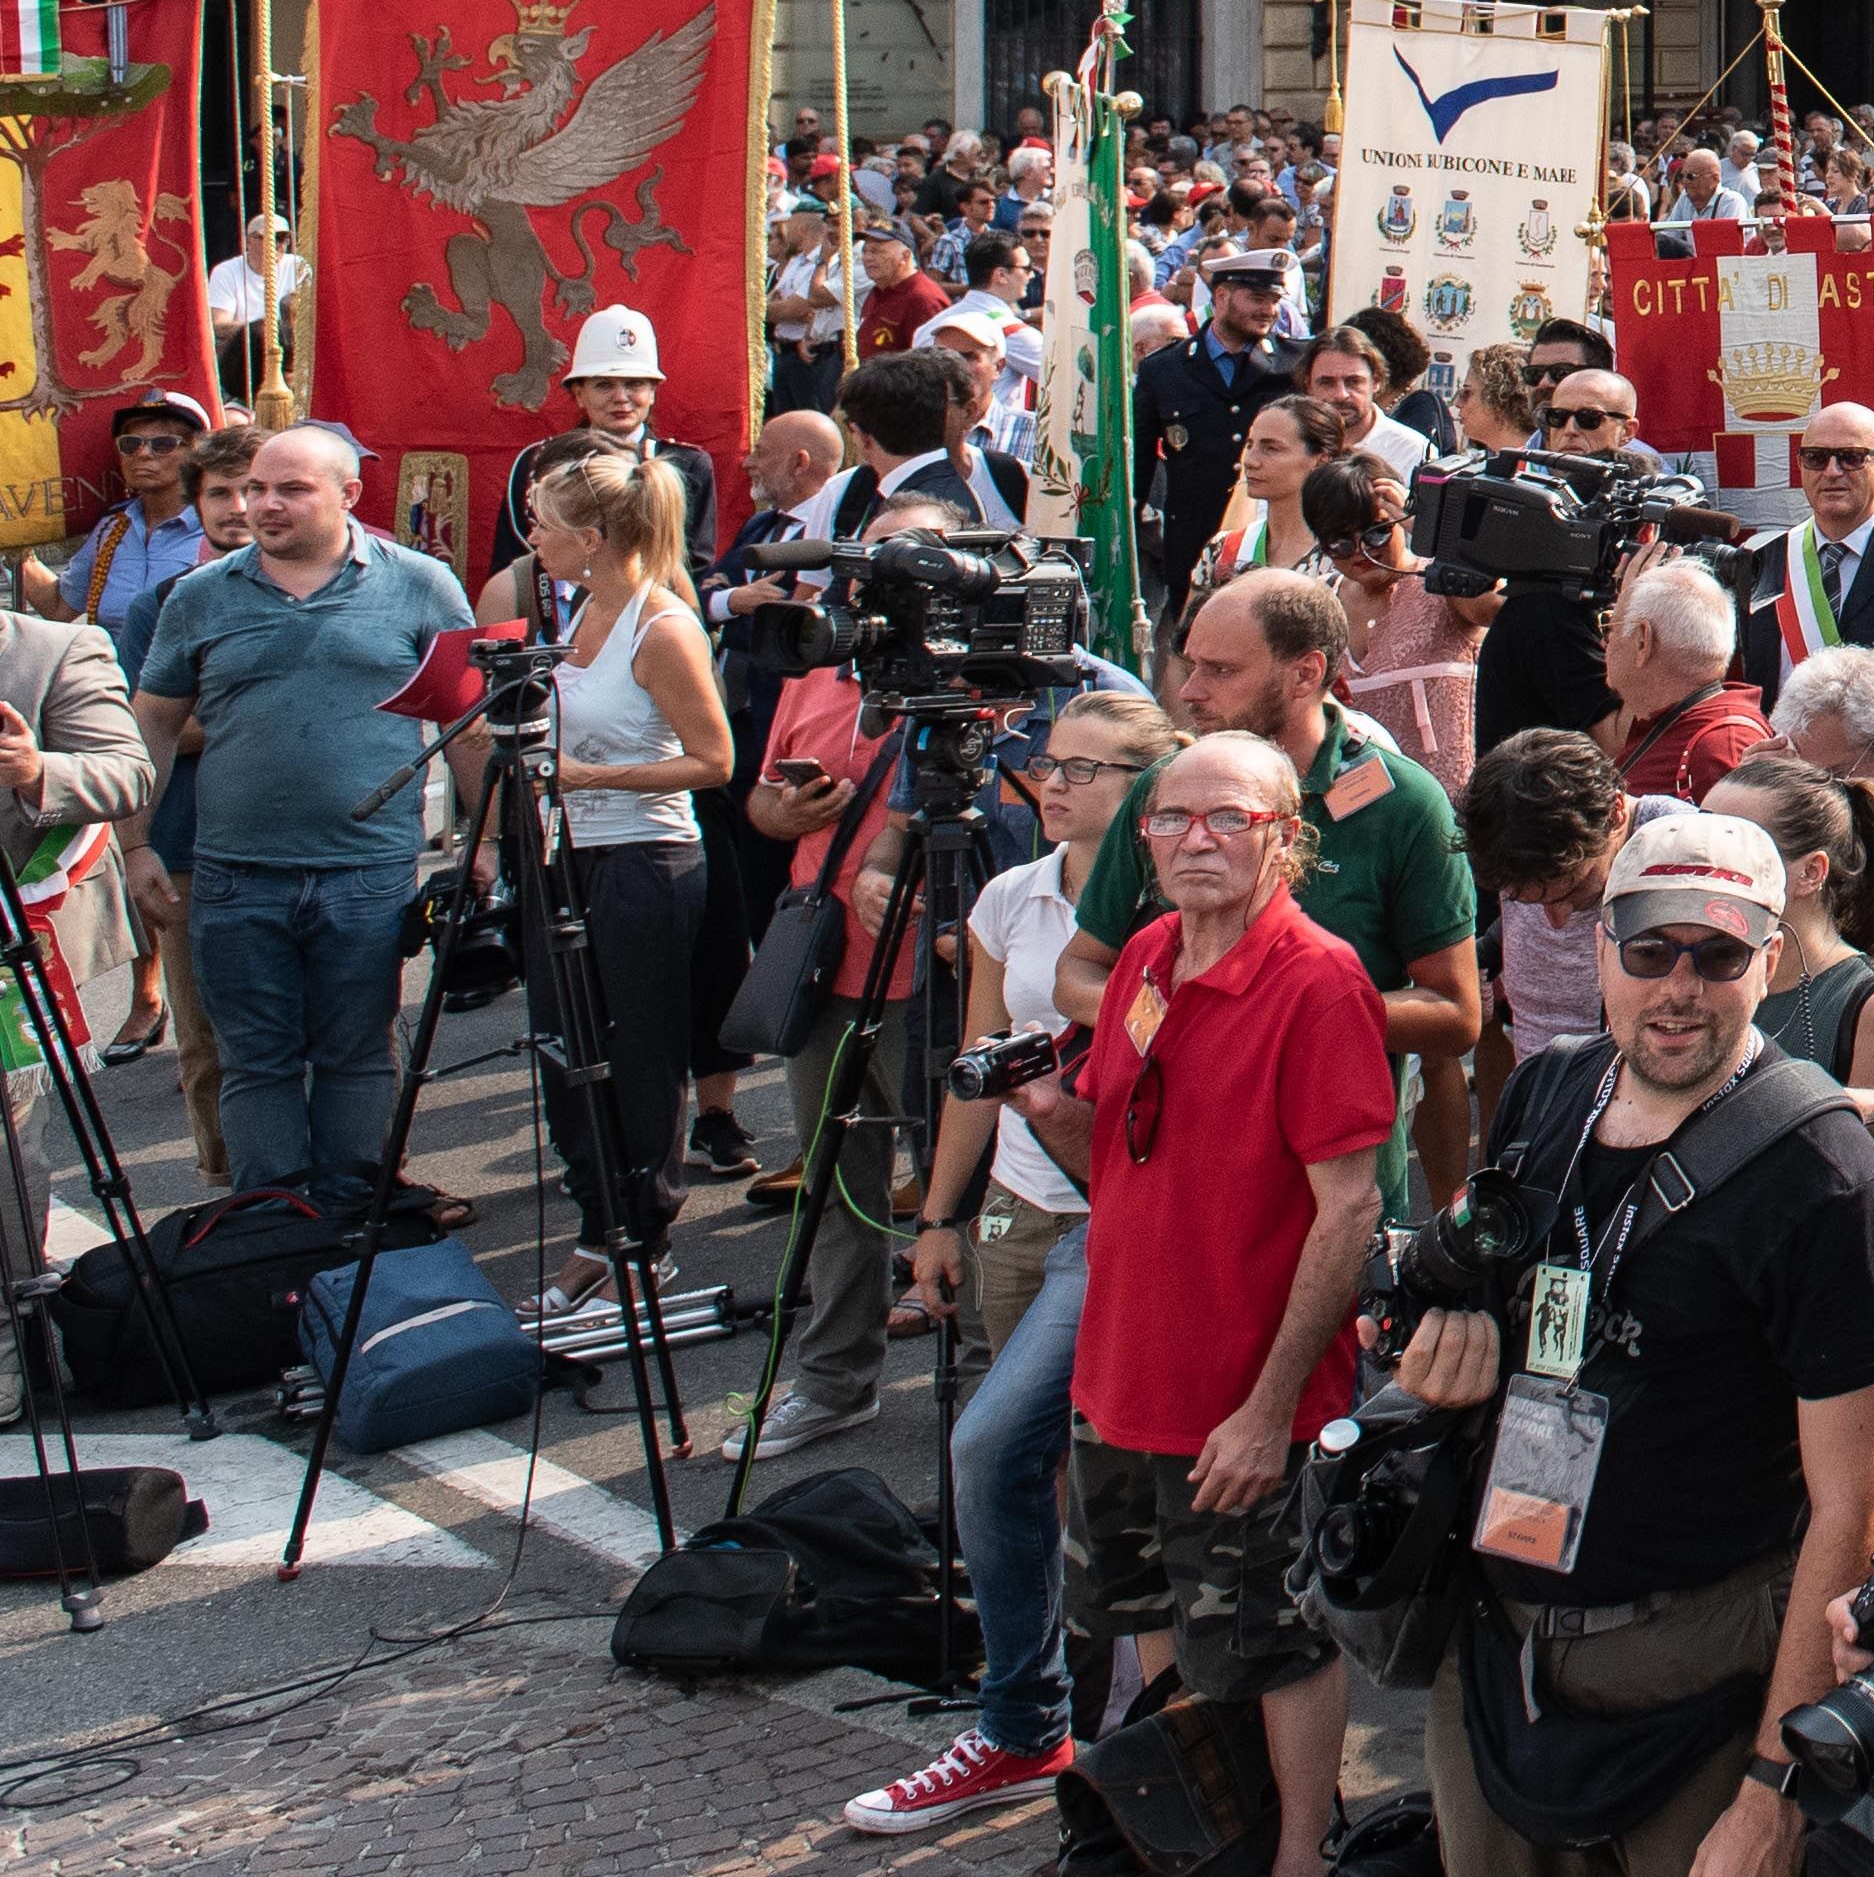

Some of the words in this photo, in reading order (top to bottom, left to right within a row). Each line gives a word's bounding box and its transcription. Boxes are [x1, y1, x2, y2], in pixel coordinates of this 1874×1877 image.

[1361, 148, 1423, 170] UNIONE
[1516, 161, 1529, 179] E
[1532, 164, 1578, 184] MARE
[1767, 273, 1789, 312] DI
[1572, 1203, 1592, 1271] SQUARE
